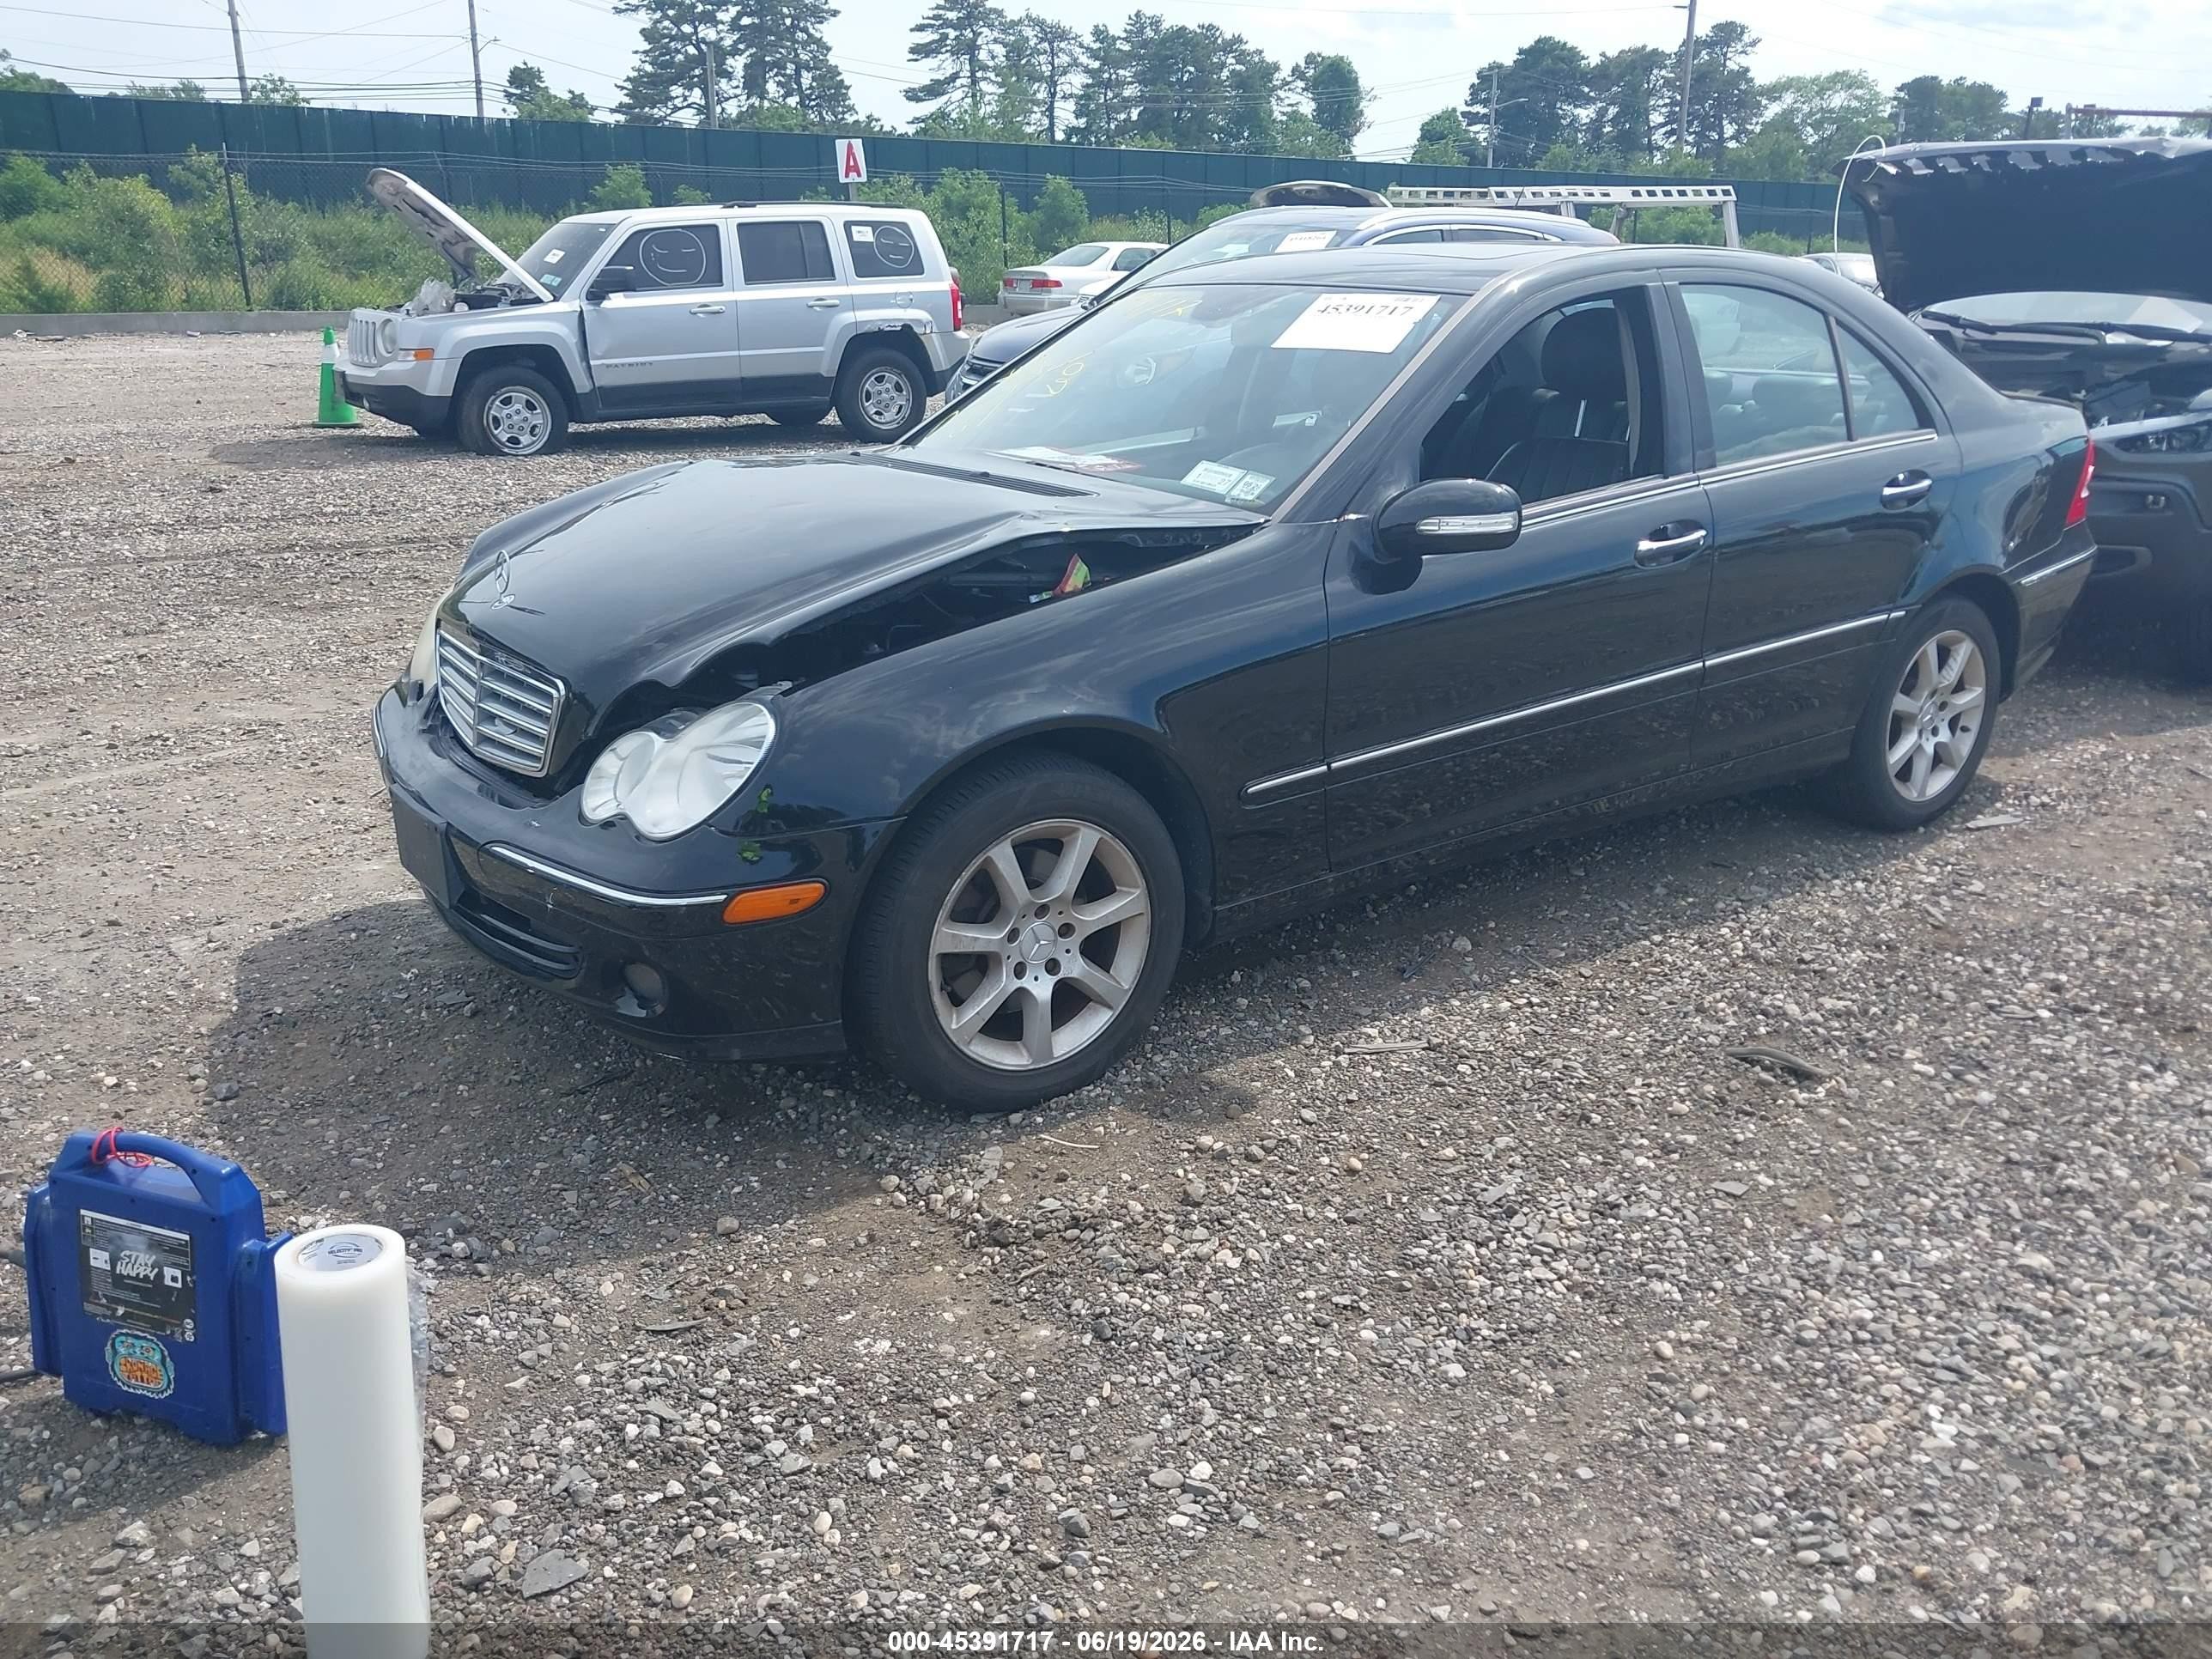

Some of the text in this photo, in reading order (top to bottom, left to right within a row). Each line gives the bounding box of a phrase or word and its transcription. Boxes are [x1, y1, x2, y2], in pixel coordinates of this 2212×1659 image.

[844, 140, 861, 179] A
[1317, 304, 1413, 316] 45391717
[120, 1250, 156, 1267] STAY
[116, 1261, 159, 1281] HAPPY
